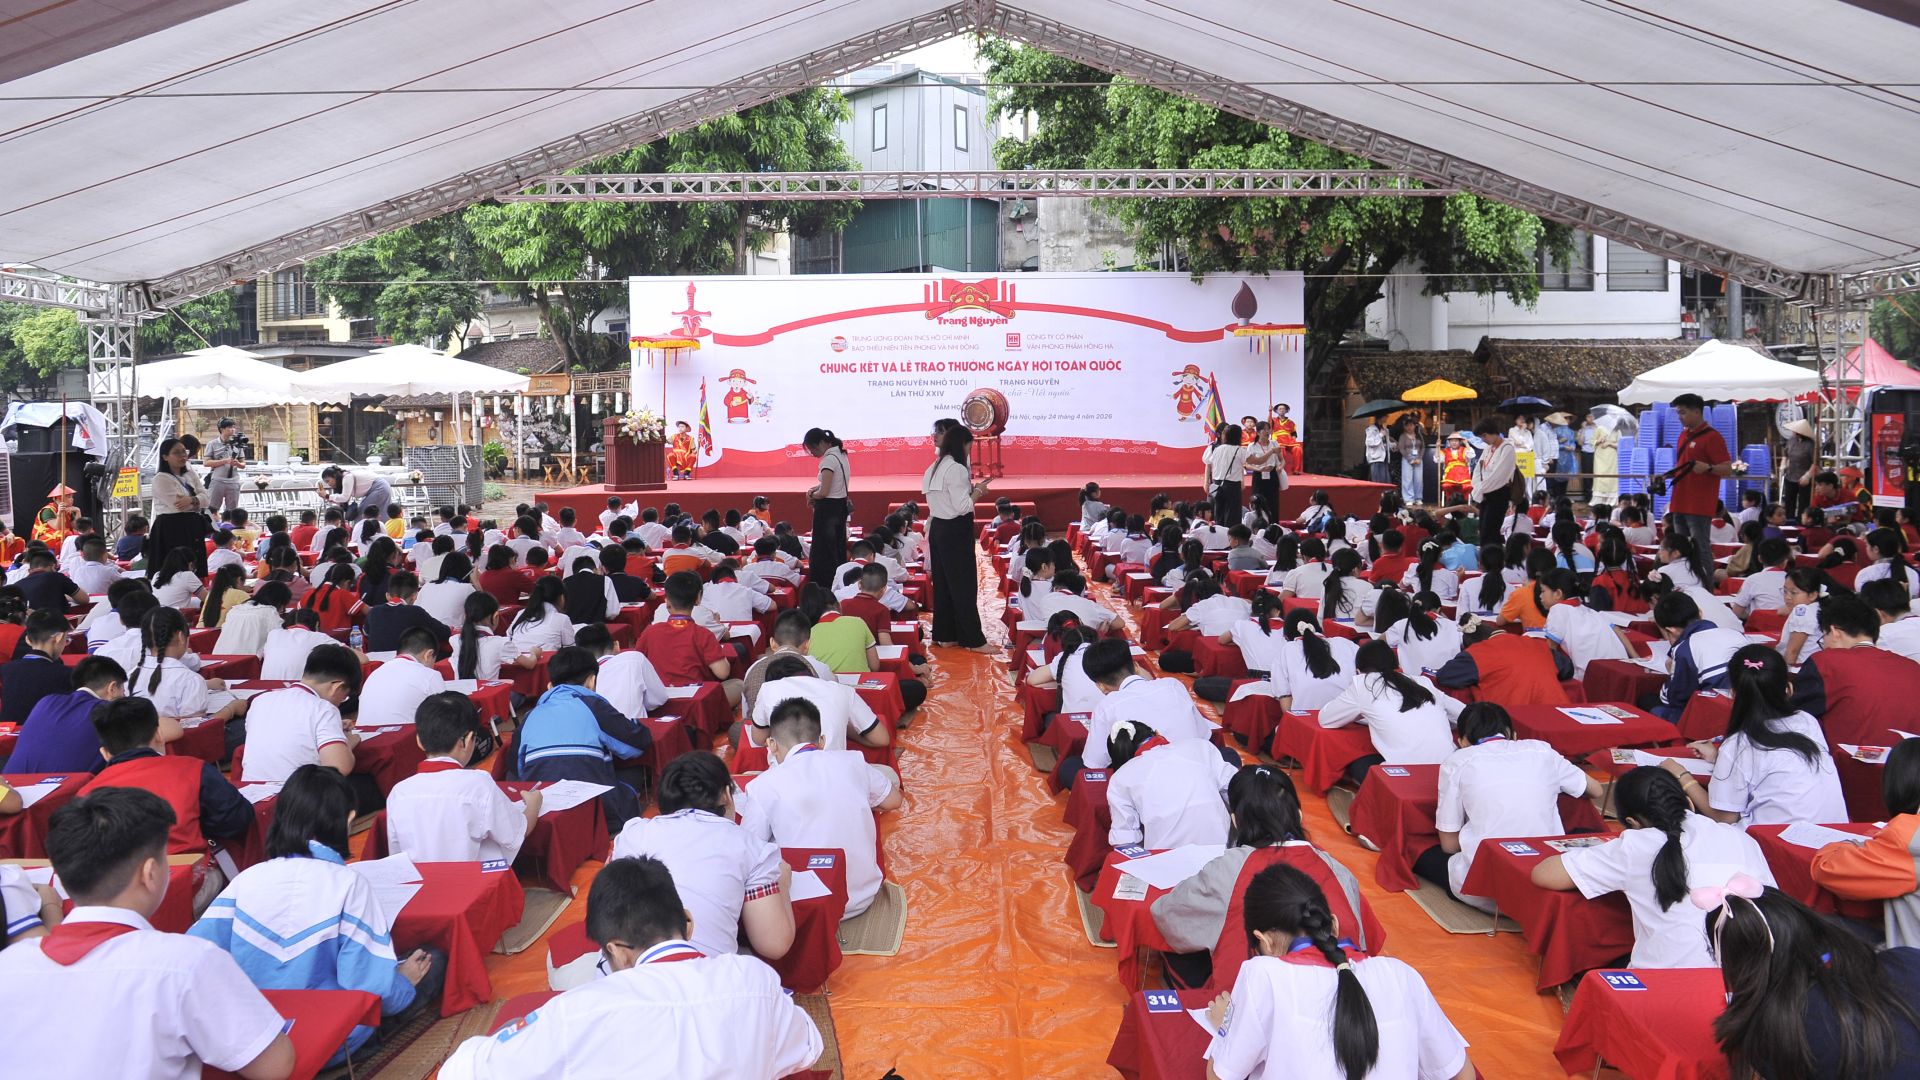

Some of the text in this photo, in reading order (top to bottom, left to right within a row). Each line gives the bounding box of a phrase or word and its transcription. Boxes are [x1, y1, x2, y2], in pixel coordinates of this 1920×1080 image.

[937, 315, 1008, 328] Trạng Nguyên
[820, 363, 857, 373] CHUNG
[860, 361, 880, 373] KẾT
[882, 362, 898, 373] VÀ
[915, 361, 946, 372] TRAO
[948, 359, 995, 372] THƯỞNG
[997, 360, 1029, 371] NGÀY
[1032, 360, 1052, 372] HỘI
[1055, 359, 1087, 371] TOÀN
[1089, 358, 1122, 371] QUỐC
[868, 380, 895, 388] TRẠNG
[896, 378, 929, 387] NGUYÊN
[1000, 378, 1060, 388] TRẠNG NGUYÊN
[482, 860, 506, 869] 275
[810, 857, 832, 865] 276
[1606, 975, 1639, 985] 315
[1148, 995, 1178, 1006] 314
